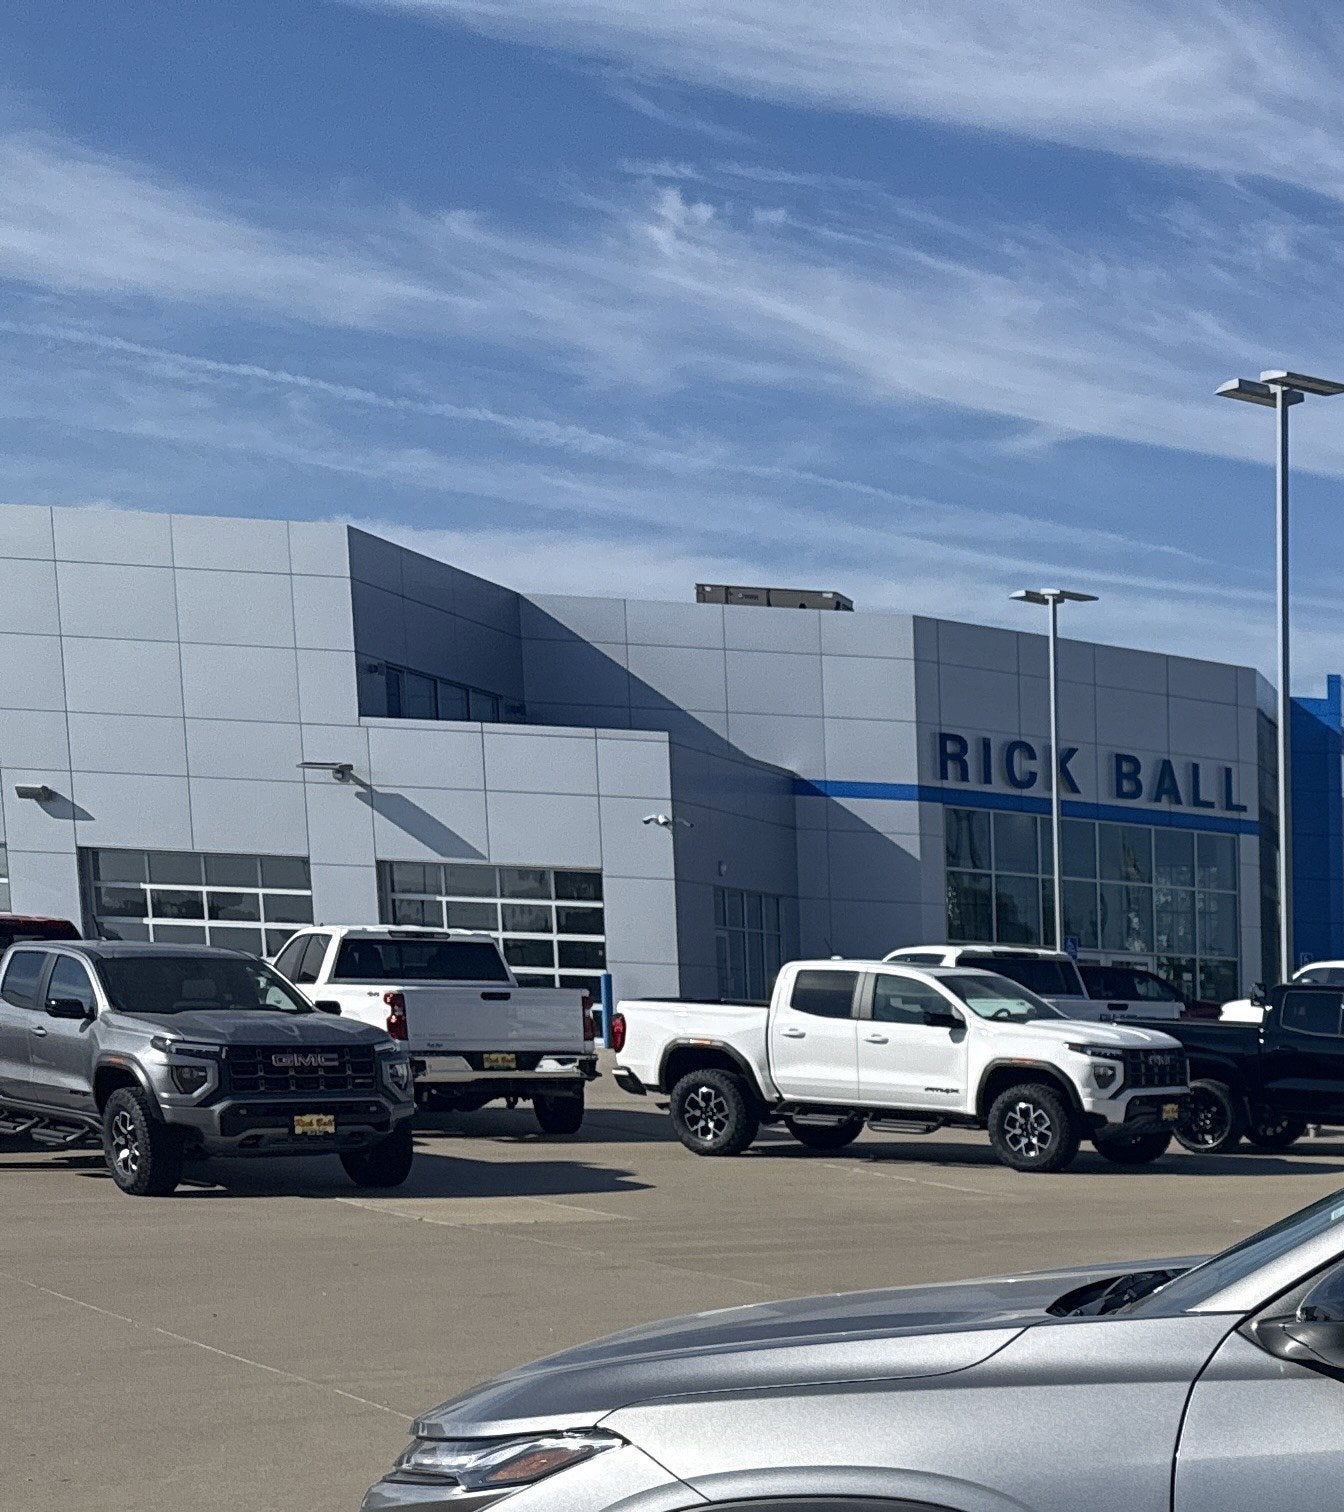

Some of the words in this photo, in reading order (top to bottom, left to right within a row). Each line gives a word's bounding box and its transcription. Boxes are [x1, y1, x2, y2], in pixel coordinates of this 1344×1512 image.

[938, 732, 1082, 795] RICK
[1115, 753, 1248, 813] BALL
[272, 1053, 339, 1067] GMC
